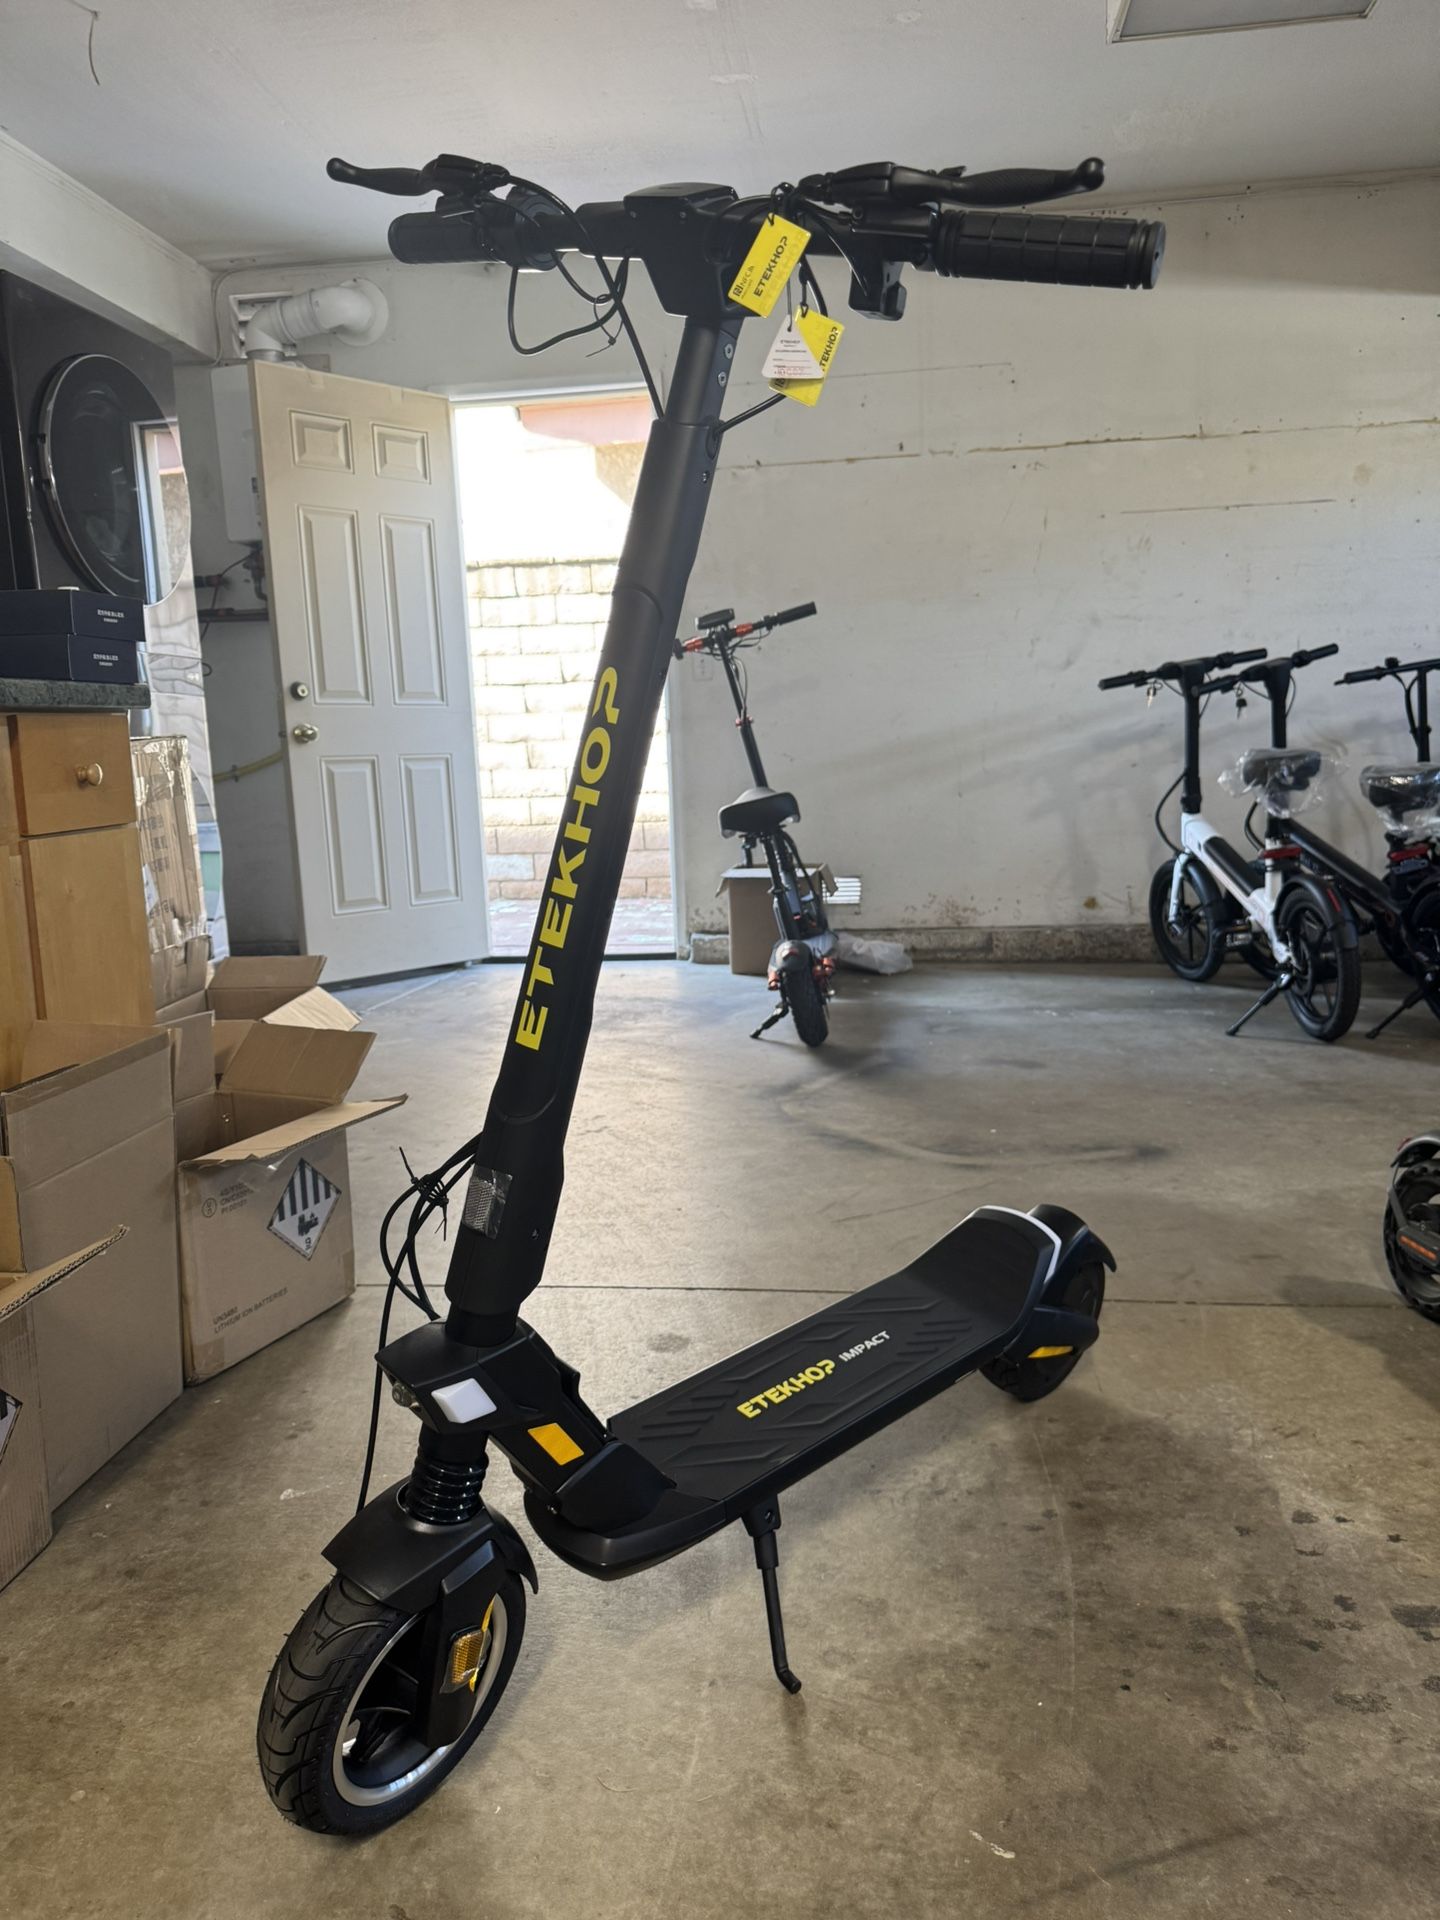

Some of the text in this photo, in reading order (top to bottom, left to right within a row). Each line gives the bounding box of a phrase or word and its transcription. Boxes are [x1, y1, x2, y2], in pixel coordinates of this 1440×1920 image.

[818, 326, 839, 372] TEKHOP
[214, 1313, 241, 1334] LITHIUM
[253, 1287, 288, 1312] BATTERIES
[838, 1330, 891, 1362] IMPACT
